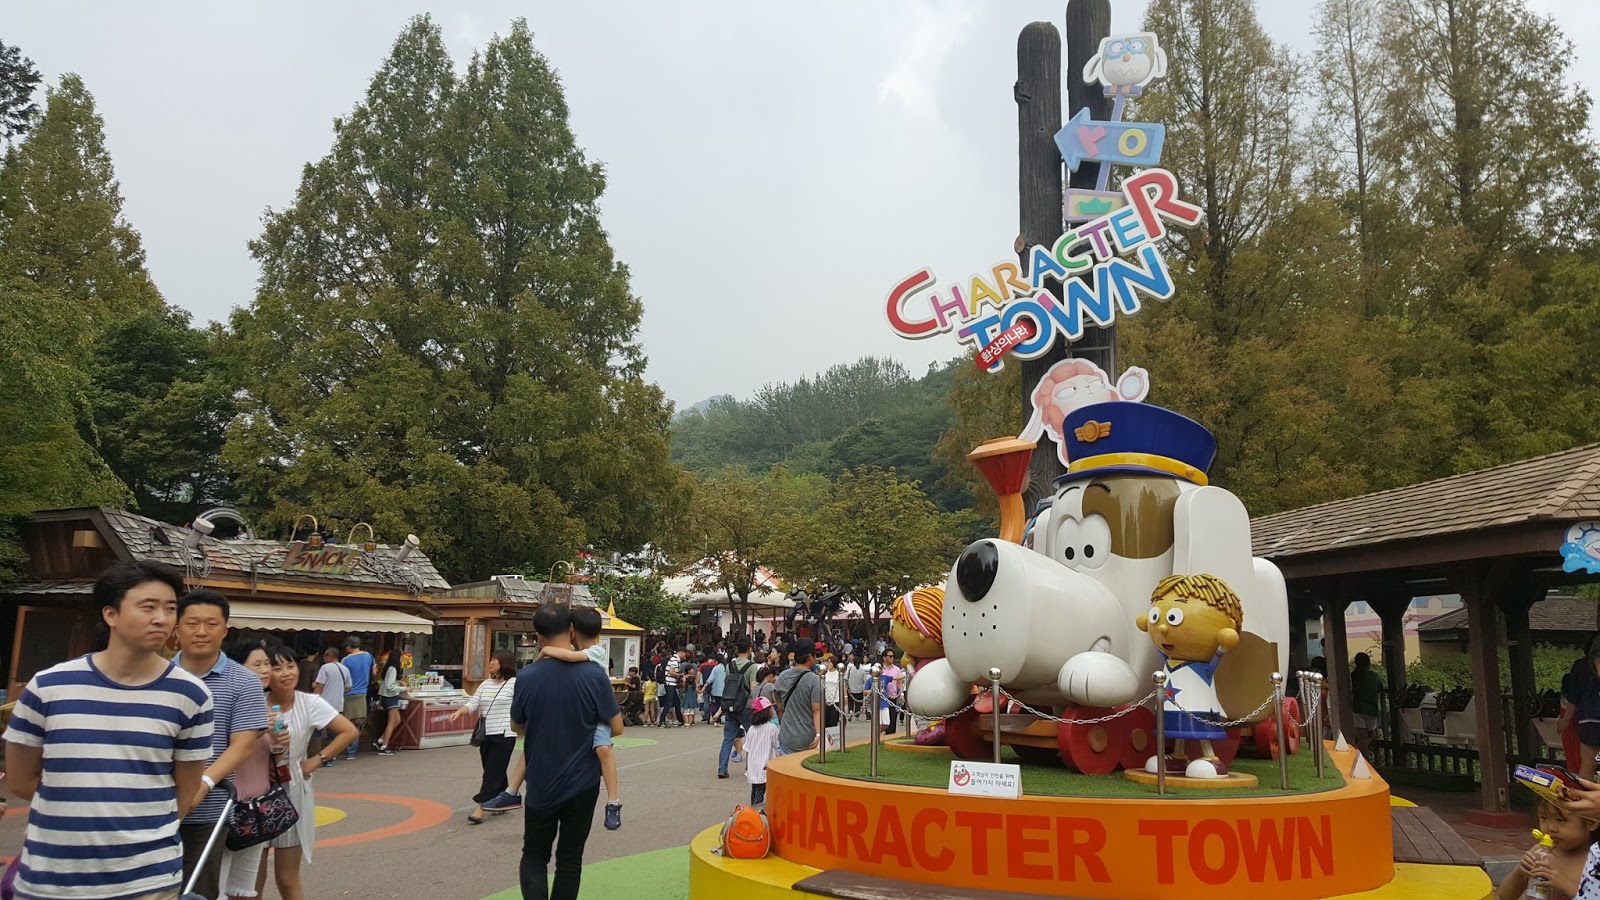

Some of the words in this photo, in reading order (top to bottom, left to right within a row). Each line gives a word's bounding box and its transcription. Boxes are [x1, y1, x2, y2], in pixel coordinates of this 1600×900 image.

[885, 171, 1201, 335] CHARACTER
[958, 246, 1171, 369] TOWN
[292, 551, 348, 569] SNACK
[970, 778, 994, 786] 들어가지
[995, 780, 1015, 789] 마세요!
[773, 786, 1112, 884] CHARACTER
[1138, 814, 1335, 886] TOWN
